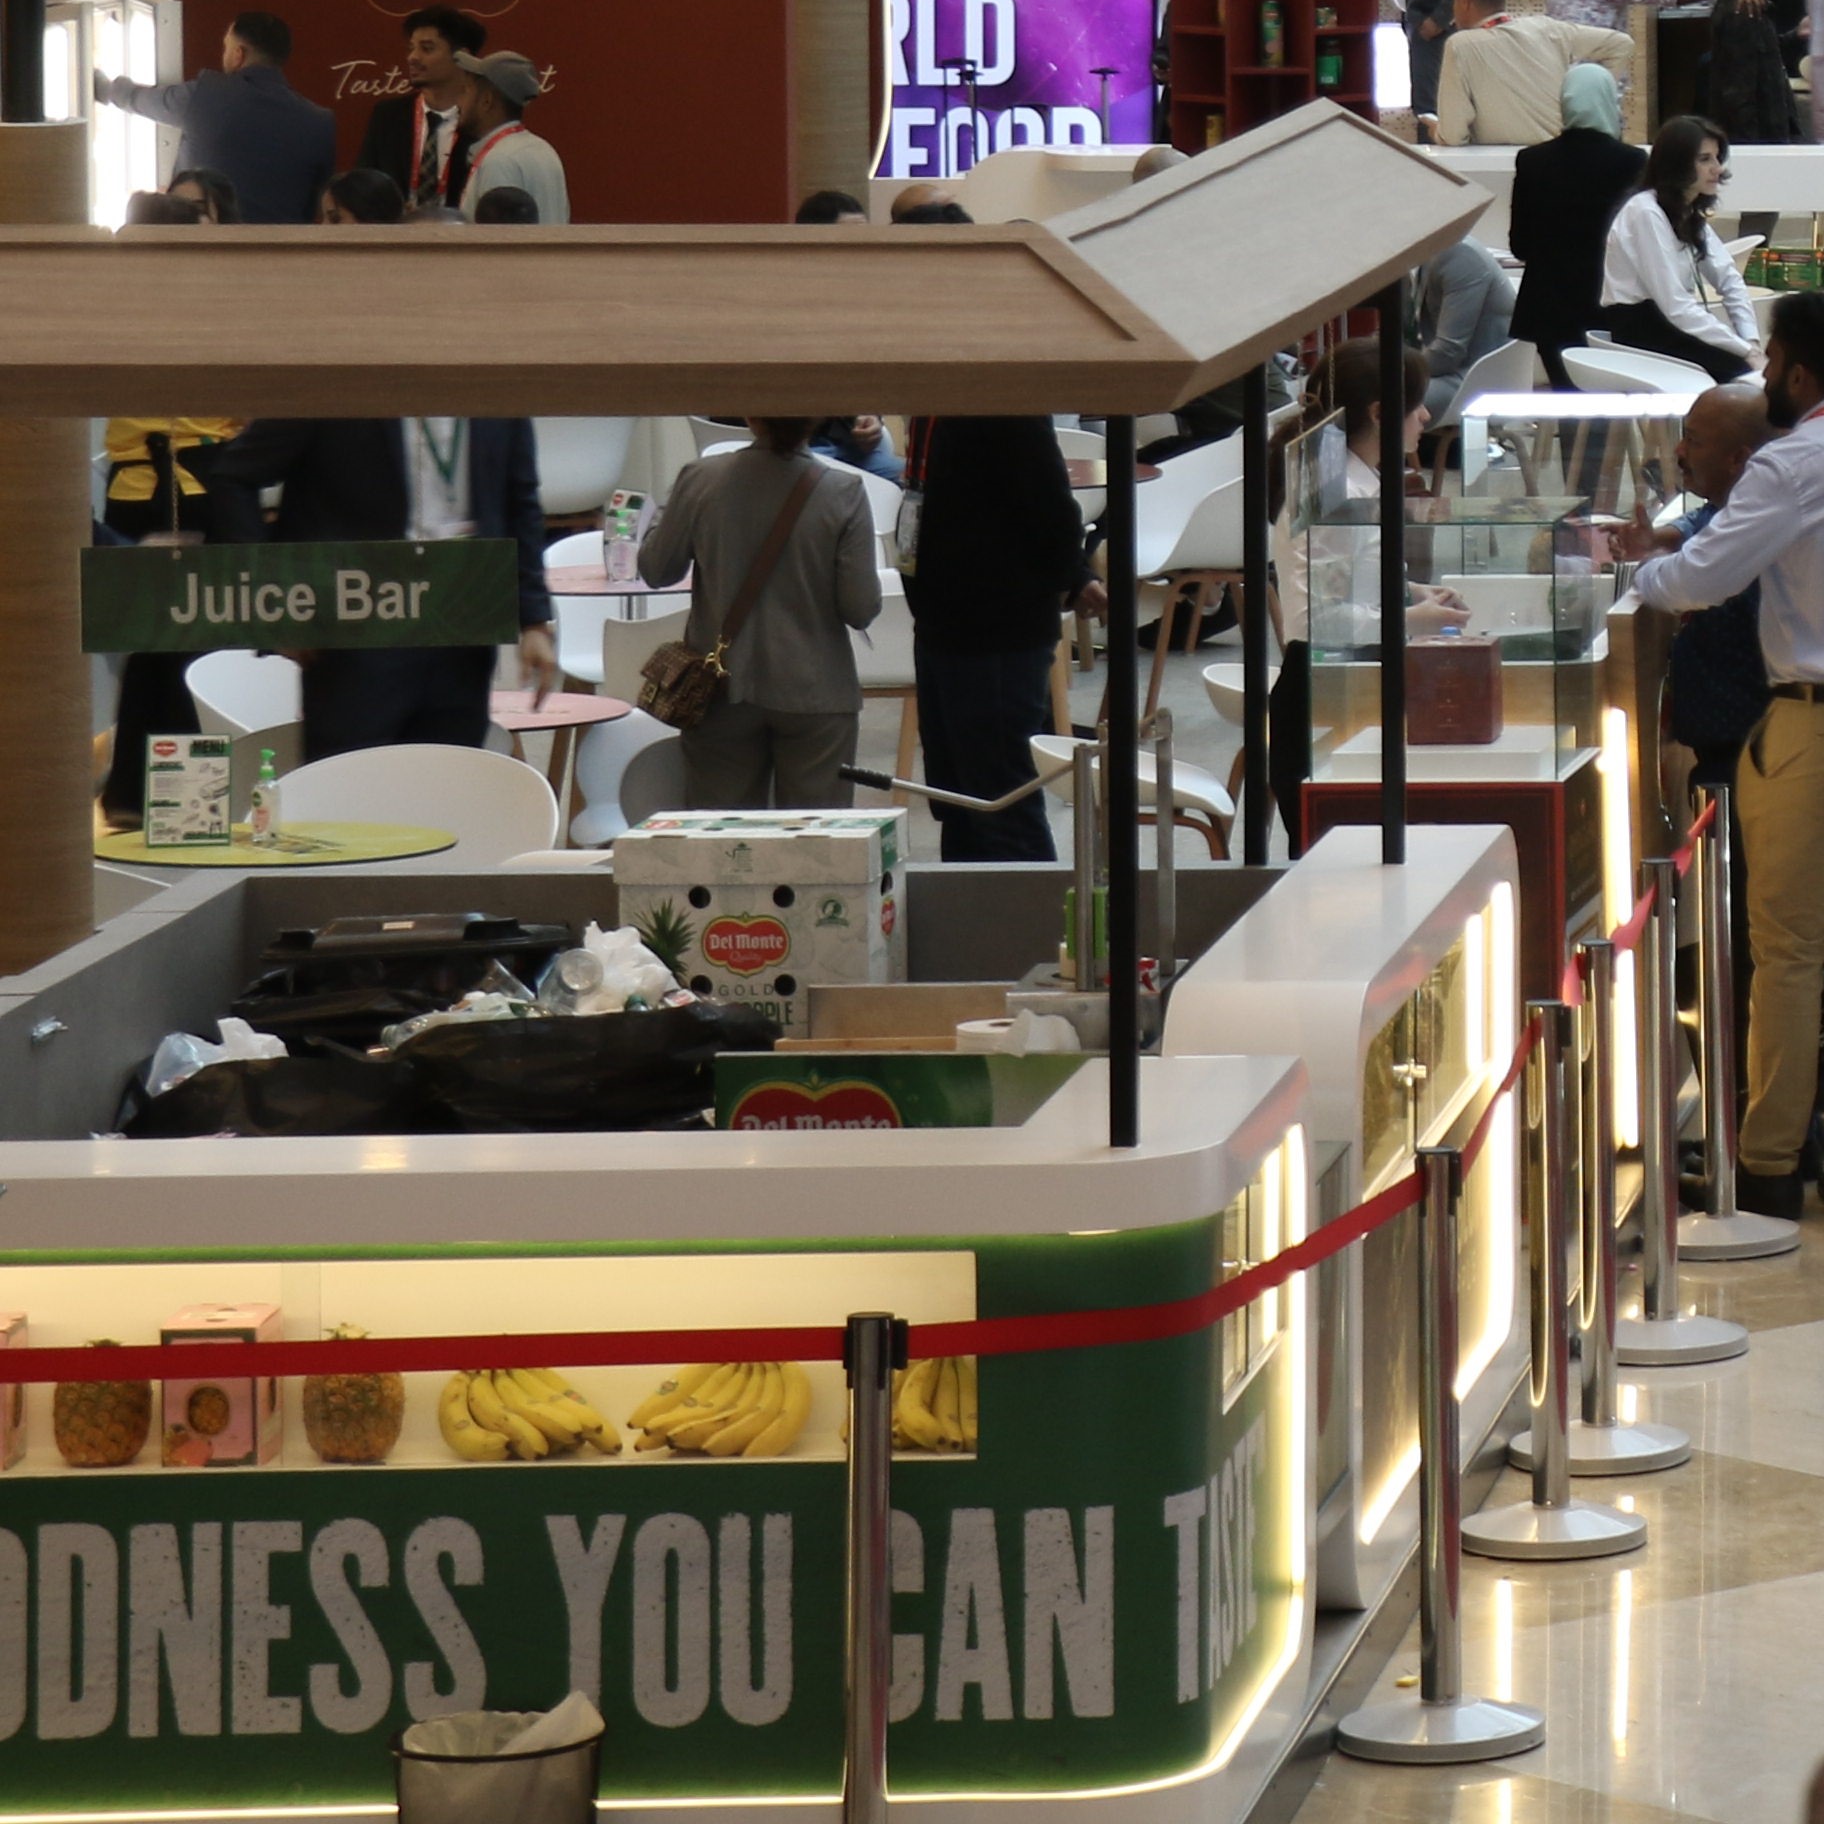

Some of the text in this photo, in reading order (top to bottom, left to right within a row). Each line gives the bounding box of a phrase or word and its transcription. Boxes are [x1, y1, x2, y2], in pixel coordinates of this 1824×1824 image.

[171, 569, 431, 624] Juice Bar
[709, 933, 784, 950] Del Monte
[718, 984, 775, 997] GOLD
[545, 1511, 794, 1728] YOU
[886, 1505, 1117, 1724] CAN
